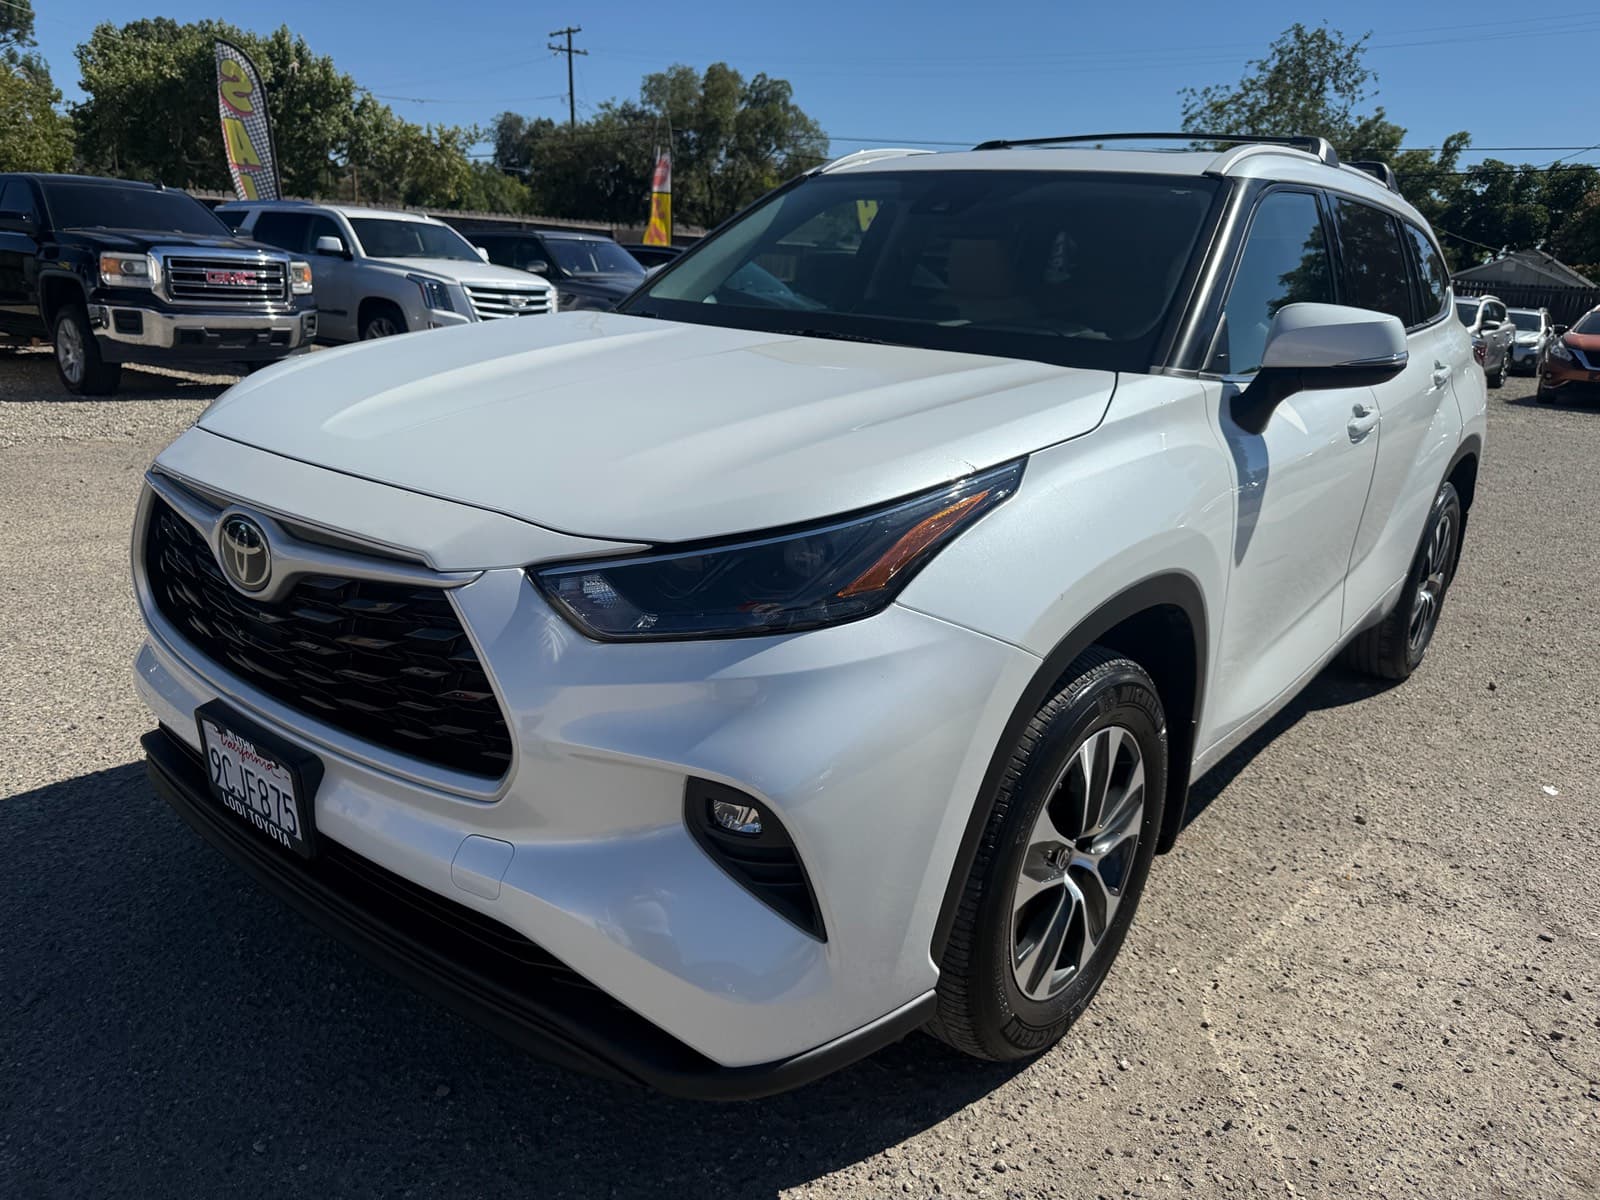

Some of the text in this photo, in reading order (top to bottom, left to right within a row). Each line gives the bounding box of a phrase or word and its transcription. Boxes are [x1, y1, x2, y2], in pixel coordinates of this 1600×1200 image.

[206, 271, 257, 286] GMC
[220, 733, 274, 771] California
[210, 747, 298, 836] 9CJF875
[222, 791, 292, 849] LODI TOYOTA
